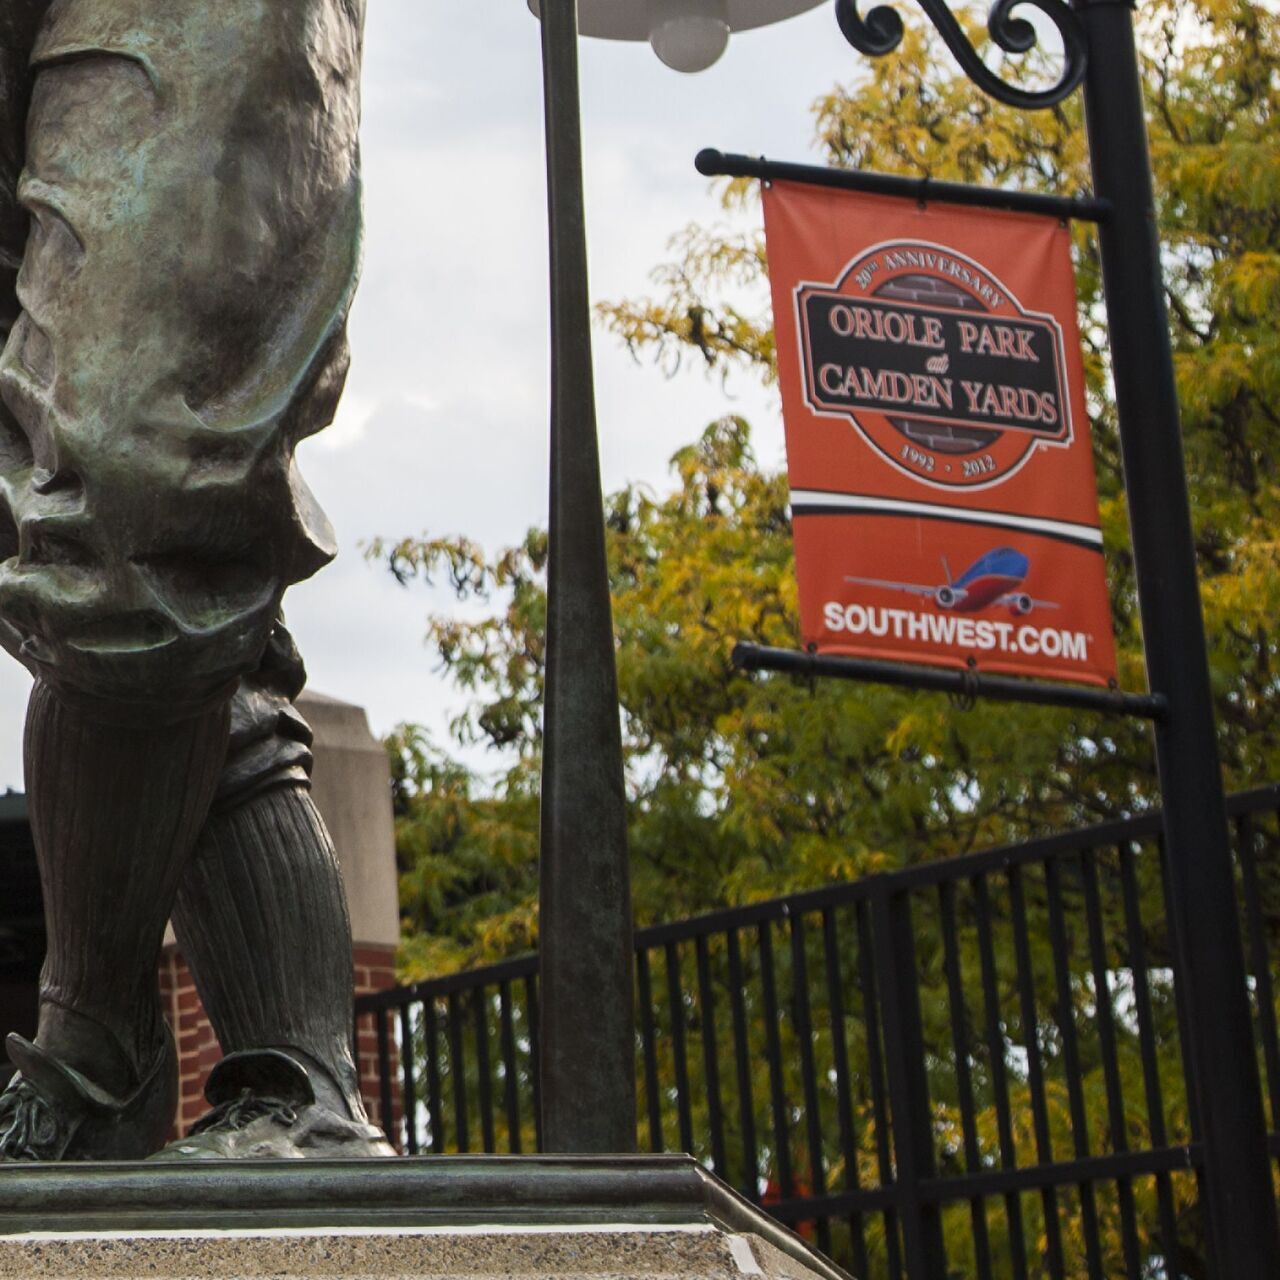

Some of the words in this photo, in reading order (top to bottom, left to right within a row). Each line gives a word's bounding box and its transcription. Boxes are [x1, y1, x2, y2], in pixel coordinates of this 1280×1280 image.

[883, 250, 1005, 309] ANNIVERSARY
[828, 304, 946, 350] ORIOLE
[957, 320, 1040, 362] PARK
[925, 354, 949, 374] at
[817, 363, 955, 410] CAMDEN
[960, 380, 1058, 425] YARDS
[900, 444, 935, 472] 1992
[962, 454, 996, 477] 2012
[823, 601, 1089, 661] SOUTHWEST.COM
